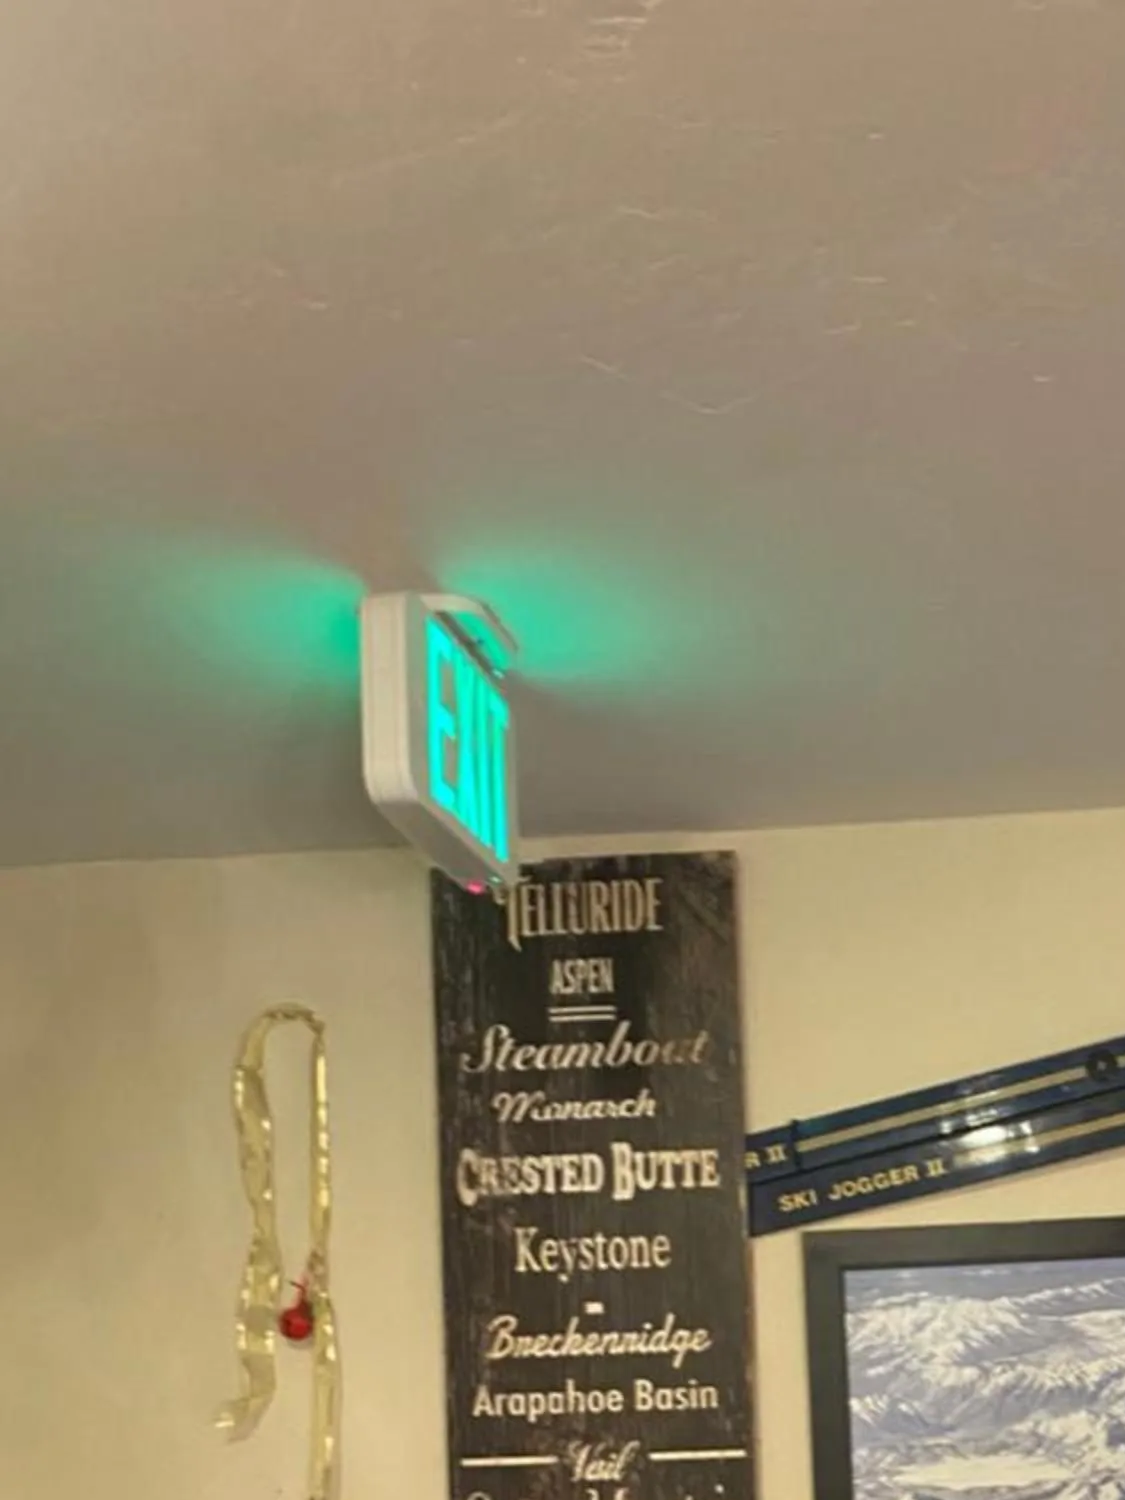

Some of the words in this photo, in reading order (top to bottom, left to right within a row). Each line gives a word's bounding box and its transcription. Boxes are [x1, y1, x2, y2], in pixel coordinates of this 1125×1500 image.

[425, 614, 509, 863] EXIT
[494, 876, 664, 951] TELLURIDE
[550, 957, 615, 995] ASPEN
[460, 1020, 710, 1074] Steamboat
[492, 1089, 658, 1123] Monarch
[456, 1147, 605, 1207] CRESTED
[610, 1141, 722, 1201] BUTTE
[778, 1189, 817, 1213] SKI
[828, 1165, 919, 1200] JOGGER
[513, 1226, 672, 1283] Keystone
[485, 1312, 711, 1368] Breckenridge
[472, 1378, 625, 1423] Arapahoe
[633, 1378, 720, 1413] Basin
[567, 1438, 641, 1483] Vail
